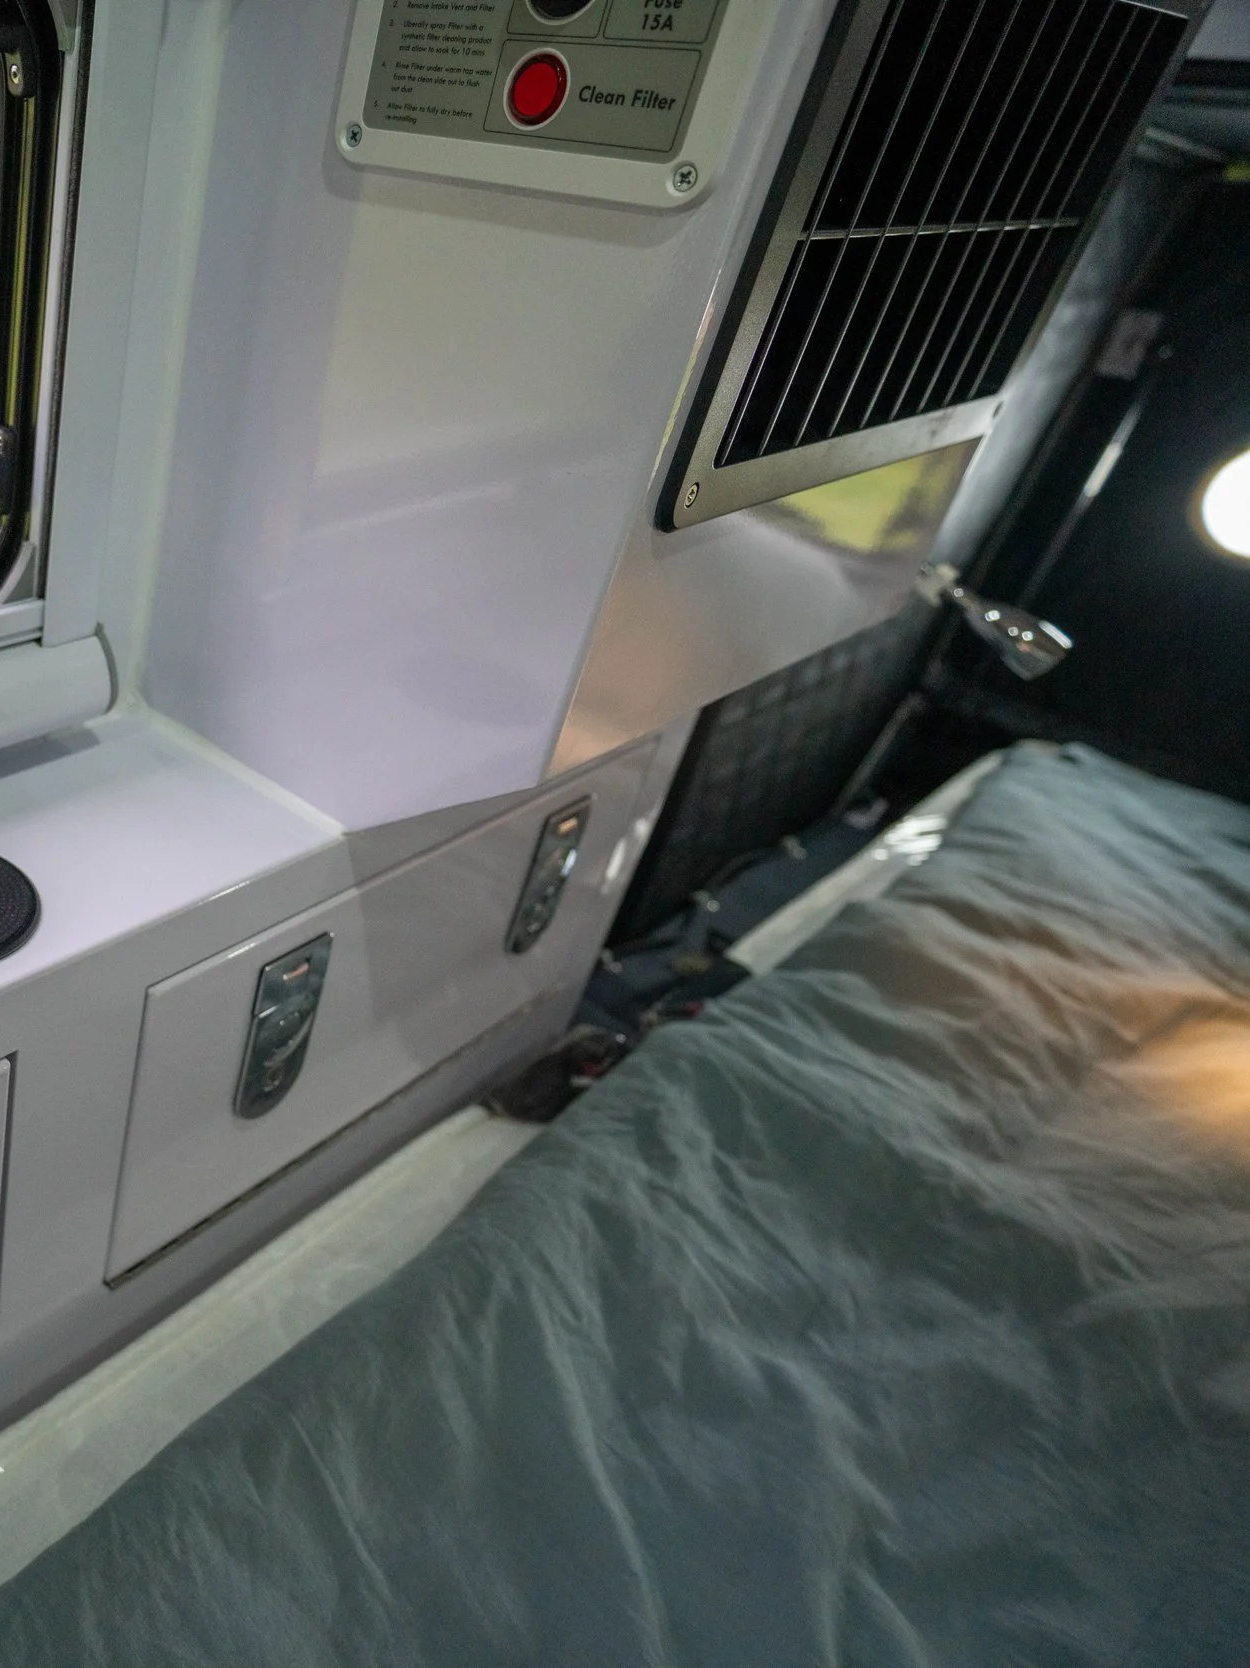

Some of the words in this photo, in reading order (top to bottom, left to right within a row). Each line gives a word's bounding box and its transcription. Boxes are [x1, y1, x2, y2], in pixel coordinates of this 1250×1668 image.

[407, 1, 429, 10] Remove
[431, 2, 448, 10] Intake
[451, 3, 464, 11] Vent
[465, 2, 478, 11] and
[479, 3, 495, 12] Filter
[403, 20, 428, 29] Liberally
[429, 23, 446, 31] spray
[448, 22, 463, 31] Filter
[465, 23, 478, 31] with
[641, 14, 673, 31] 15A
[426, 34, 440, 42] filter
[442, 34, 467, 44] cleaning
[468, 36, 492, 45] product
[399, 44, 411, 52] and
[412, 45, 427, 53] allow
[436, 46, 449, 54] soak
[462, 47, 470, 55] 10
[411, 62, 425, 71] Filter
[426, 63, 443, 72] under
[445, 65, 462, 73] warm
[463, 66, 474, 75] tap
[475, 68, 493, 76] water
[393, 73, 407, 81] from
[408, 74, 417, 82] the
[417, 75, 433, 83] clean
[434, 76, 446, 85] side
[447, 78, 458, 86] out
[466, 79, 480, 87] flush
[578, 85, 626, 106] Clean
[631, 89, 676, 111] Filter
[387, 101, 402, 110] Allow
[403, 103, 418, 112] Filter
[419, 105, 425, 113] to
[427, 105, 439, 115] fully
[440, 107, 451, 117] dry
[452, 108, 473, 118] before
